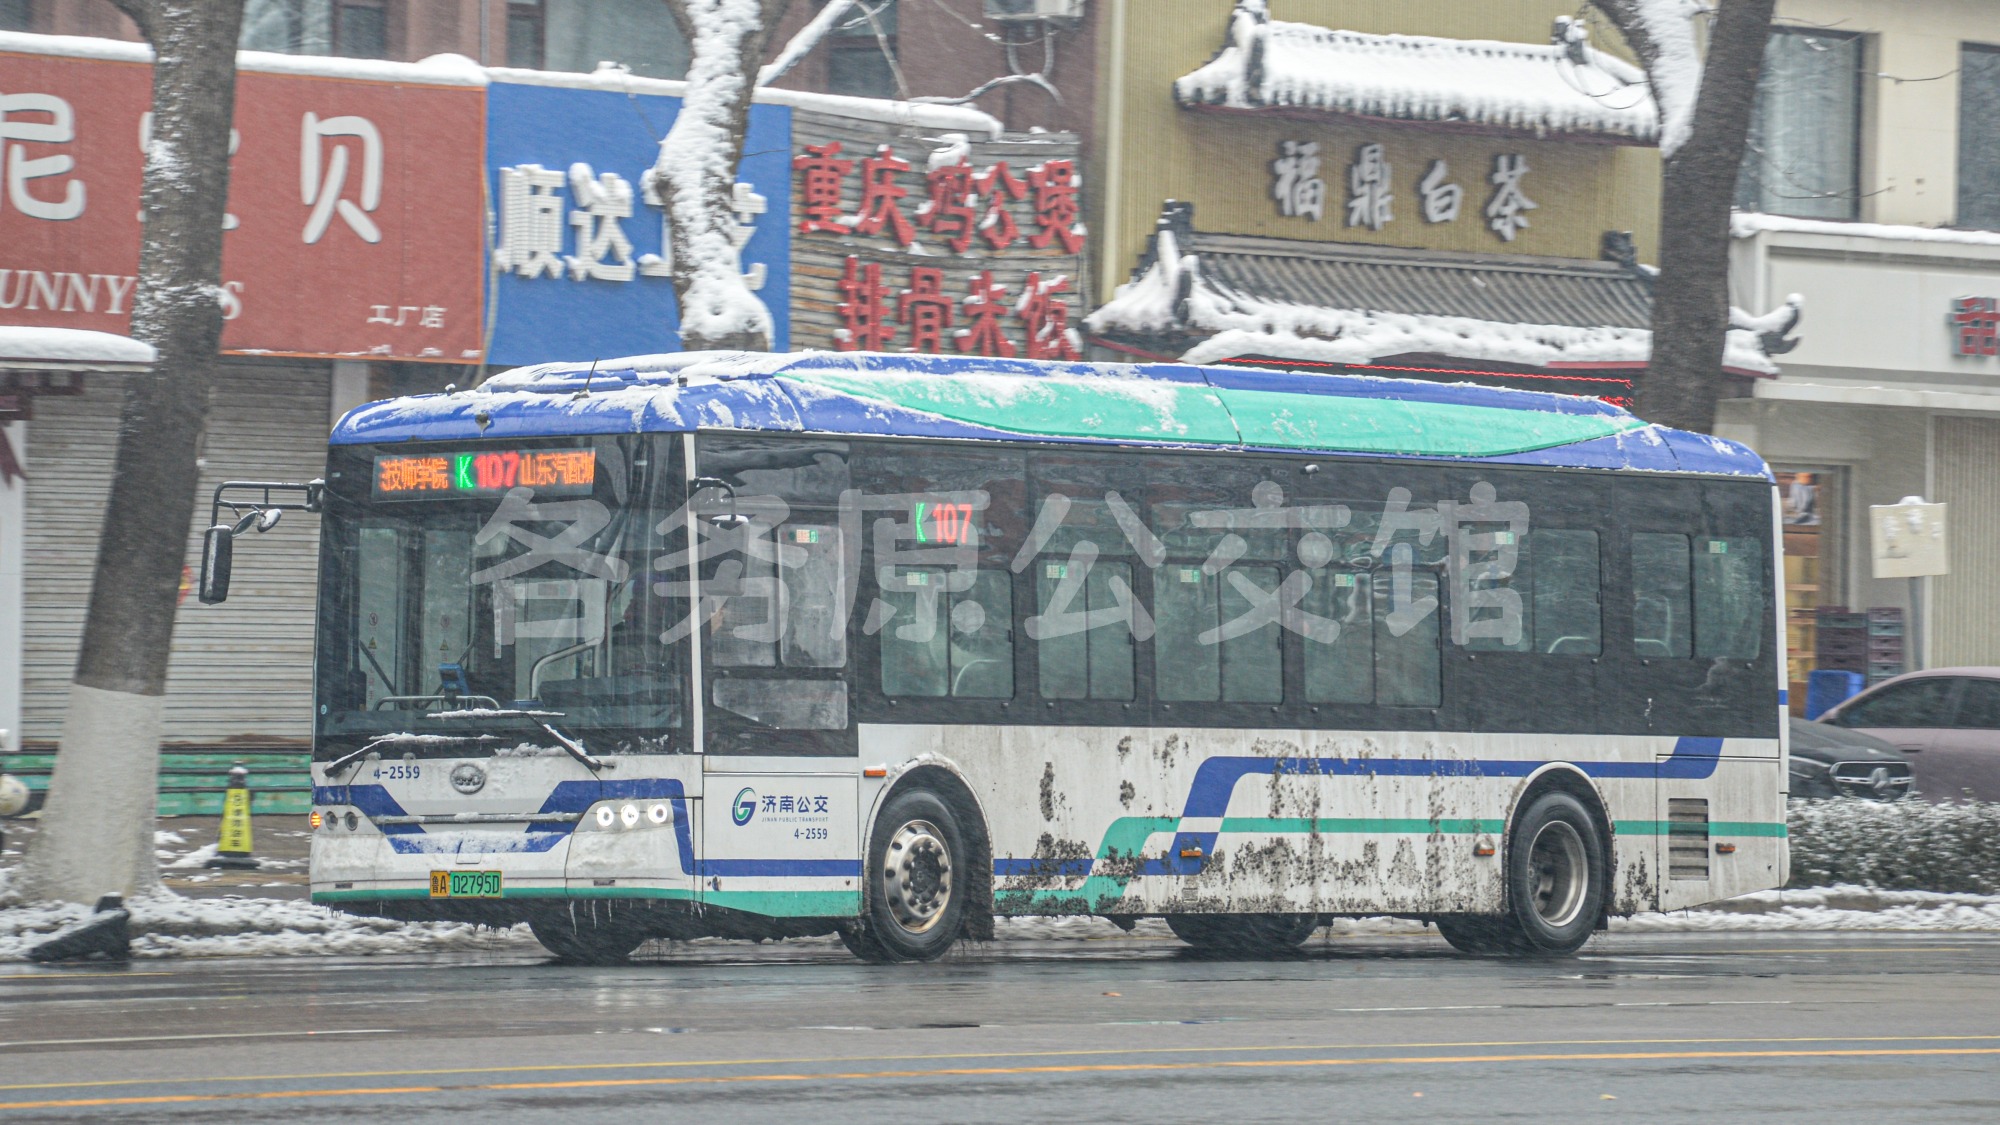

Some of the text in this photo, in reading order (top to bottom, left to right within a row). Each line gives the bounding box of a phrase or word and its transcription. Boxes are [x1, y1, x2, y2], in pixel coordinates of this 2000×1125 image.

[794, 141, 1087, 254] 重庆鸡公煲
[1274, 139, 1539, 241] 福鼎白茶
[366, 304, 448, 328] 工厂店
[834, 254, 1083, 361] 排骨米饭
[374, 765, 420, 780] 4-2559
[761, 795, 829, 813] 济南公交
[794, 828, 828, 840] 4-2559
